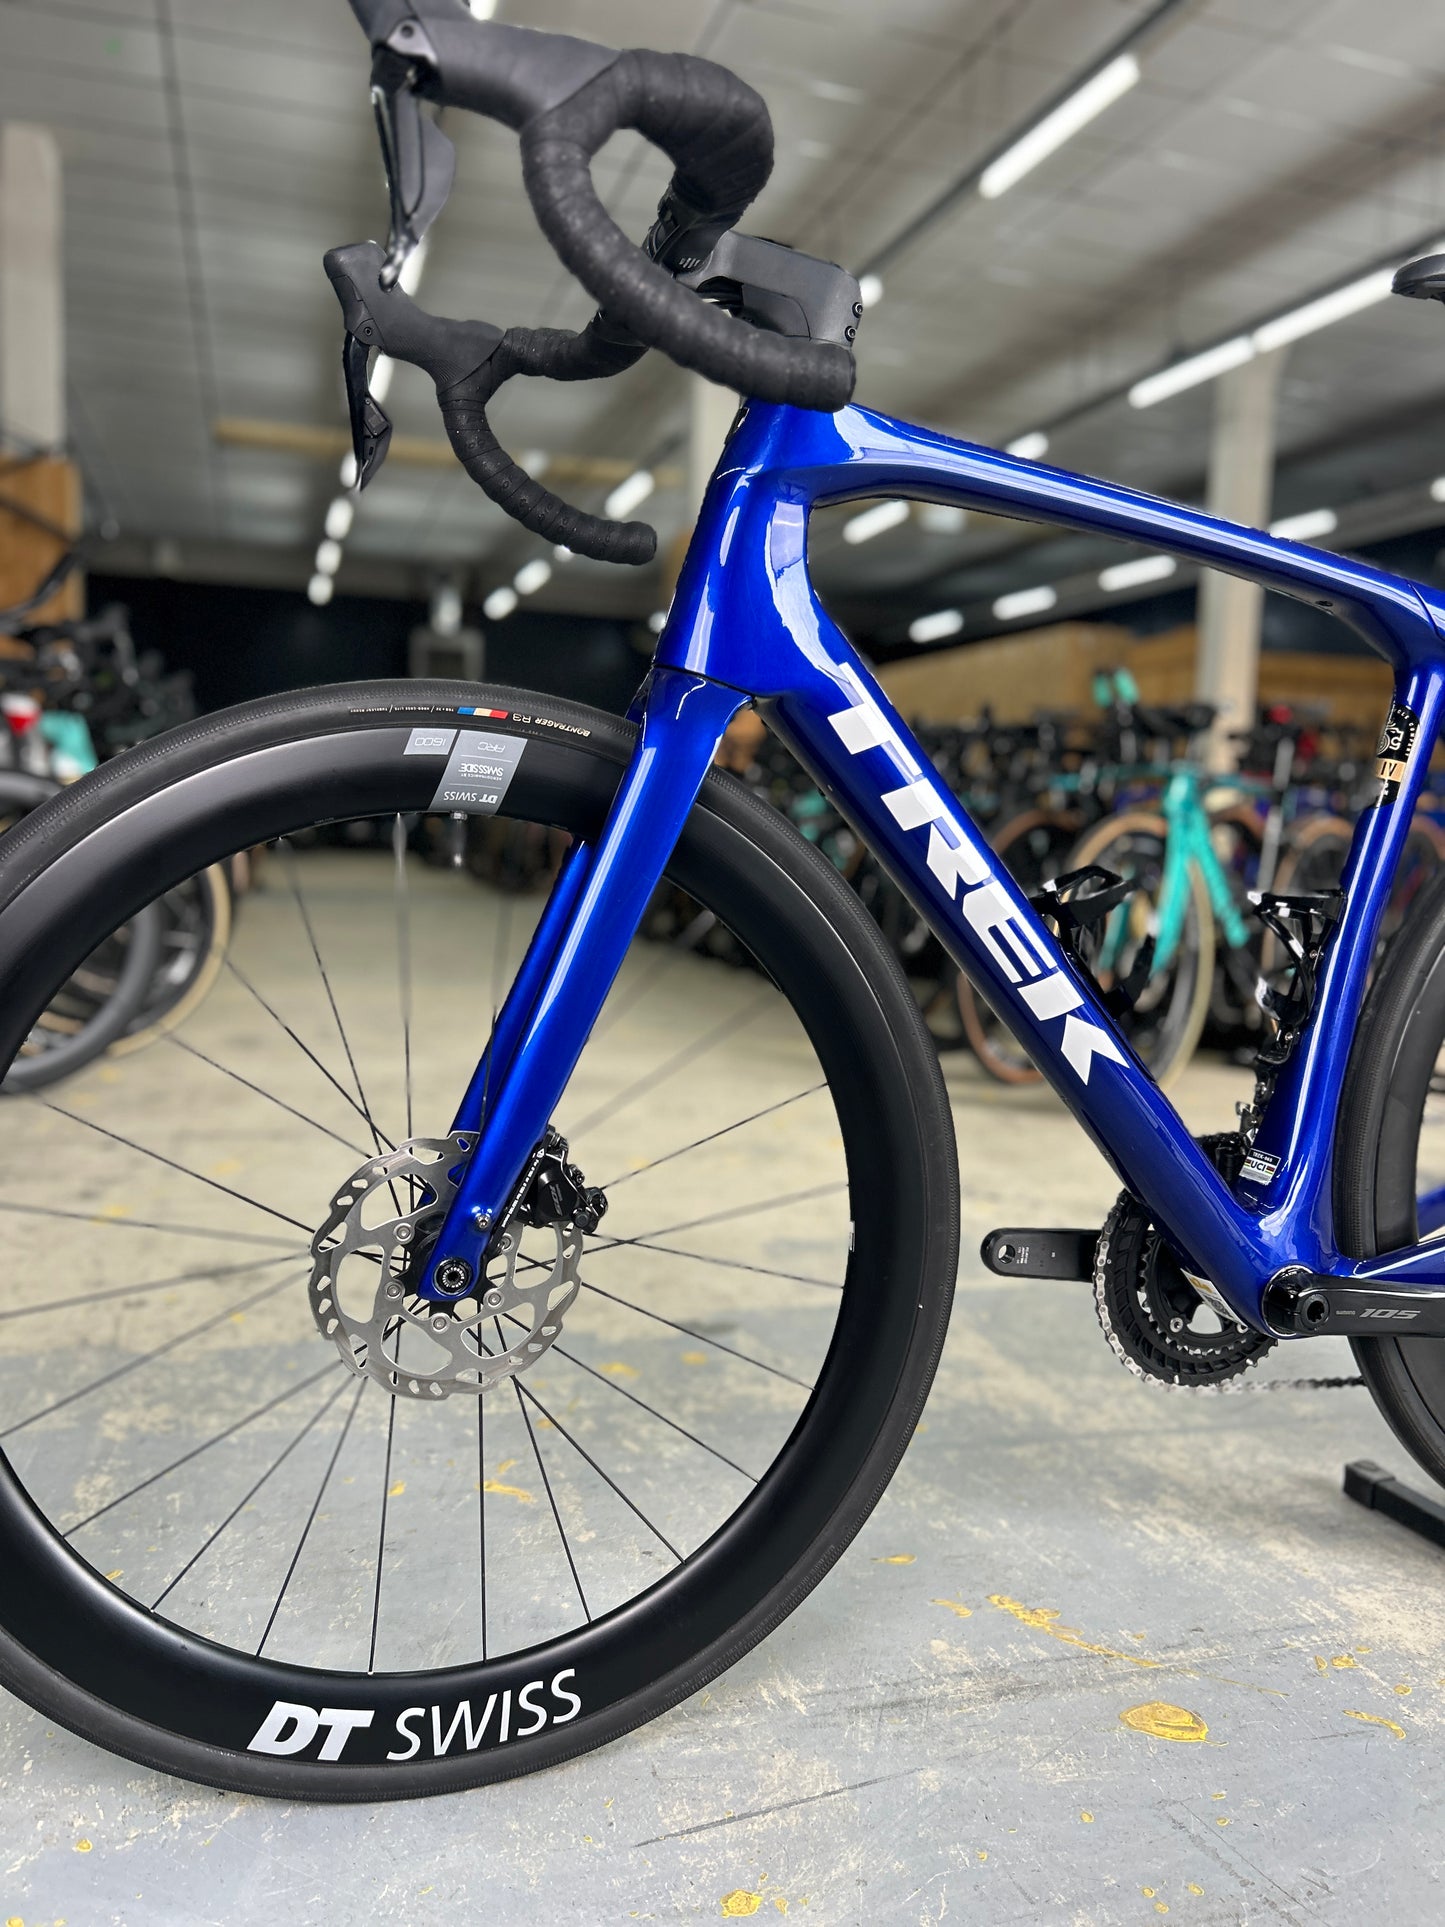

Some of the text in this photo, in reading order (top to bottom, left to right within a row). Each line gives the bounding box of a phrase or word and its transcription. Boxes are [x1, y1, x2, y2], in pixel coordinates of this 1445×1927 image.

[512, 713, 532, 723] R3
[534, 716, 591, 737] BONTRAGER
[415, 737, 446, 747] 1600
[477, 741, 506, 753] ARC
[1380, 761, 1398, 777] IV
[443, 791, 499, 804] DT SWISS
[828, 662, 1130, 1086] TREK
[1250, 1160, 1267, 1172] UCI
[1359, 1308, 1421, 1320] 105
[247, 1668, 582, 1762] DT SWISS
